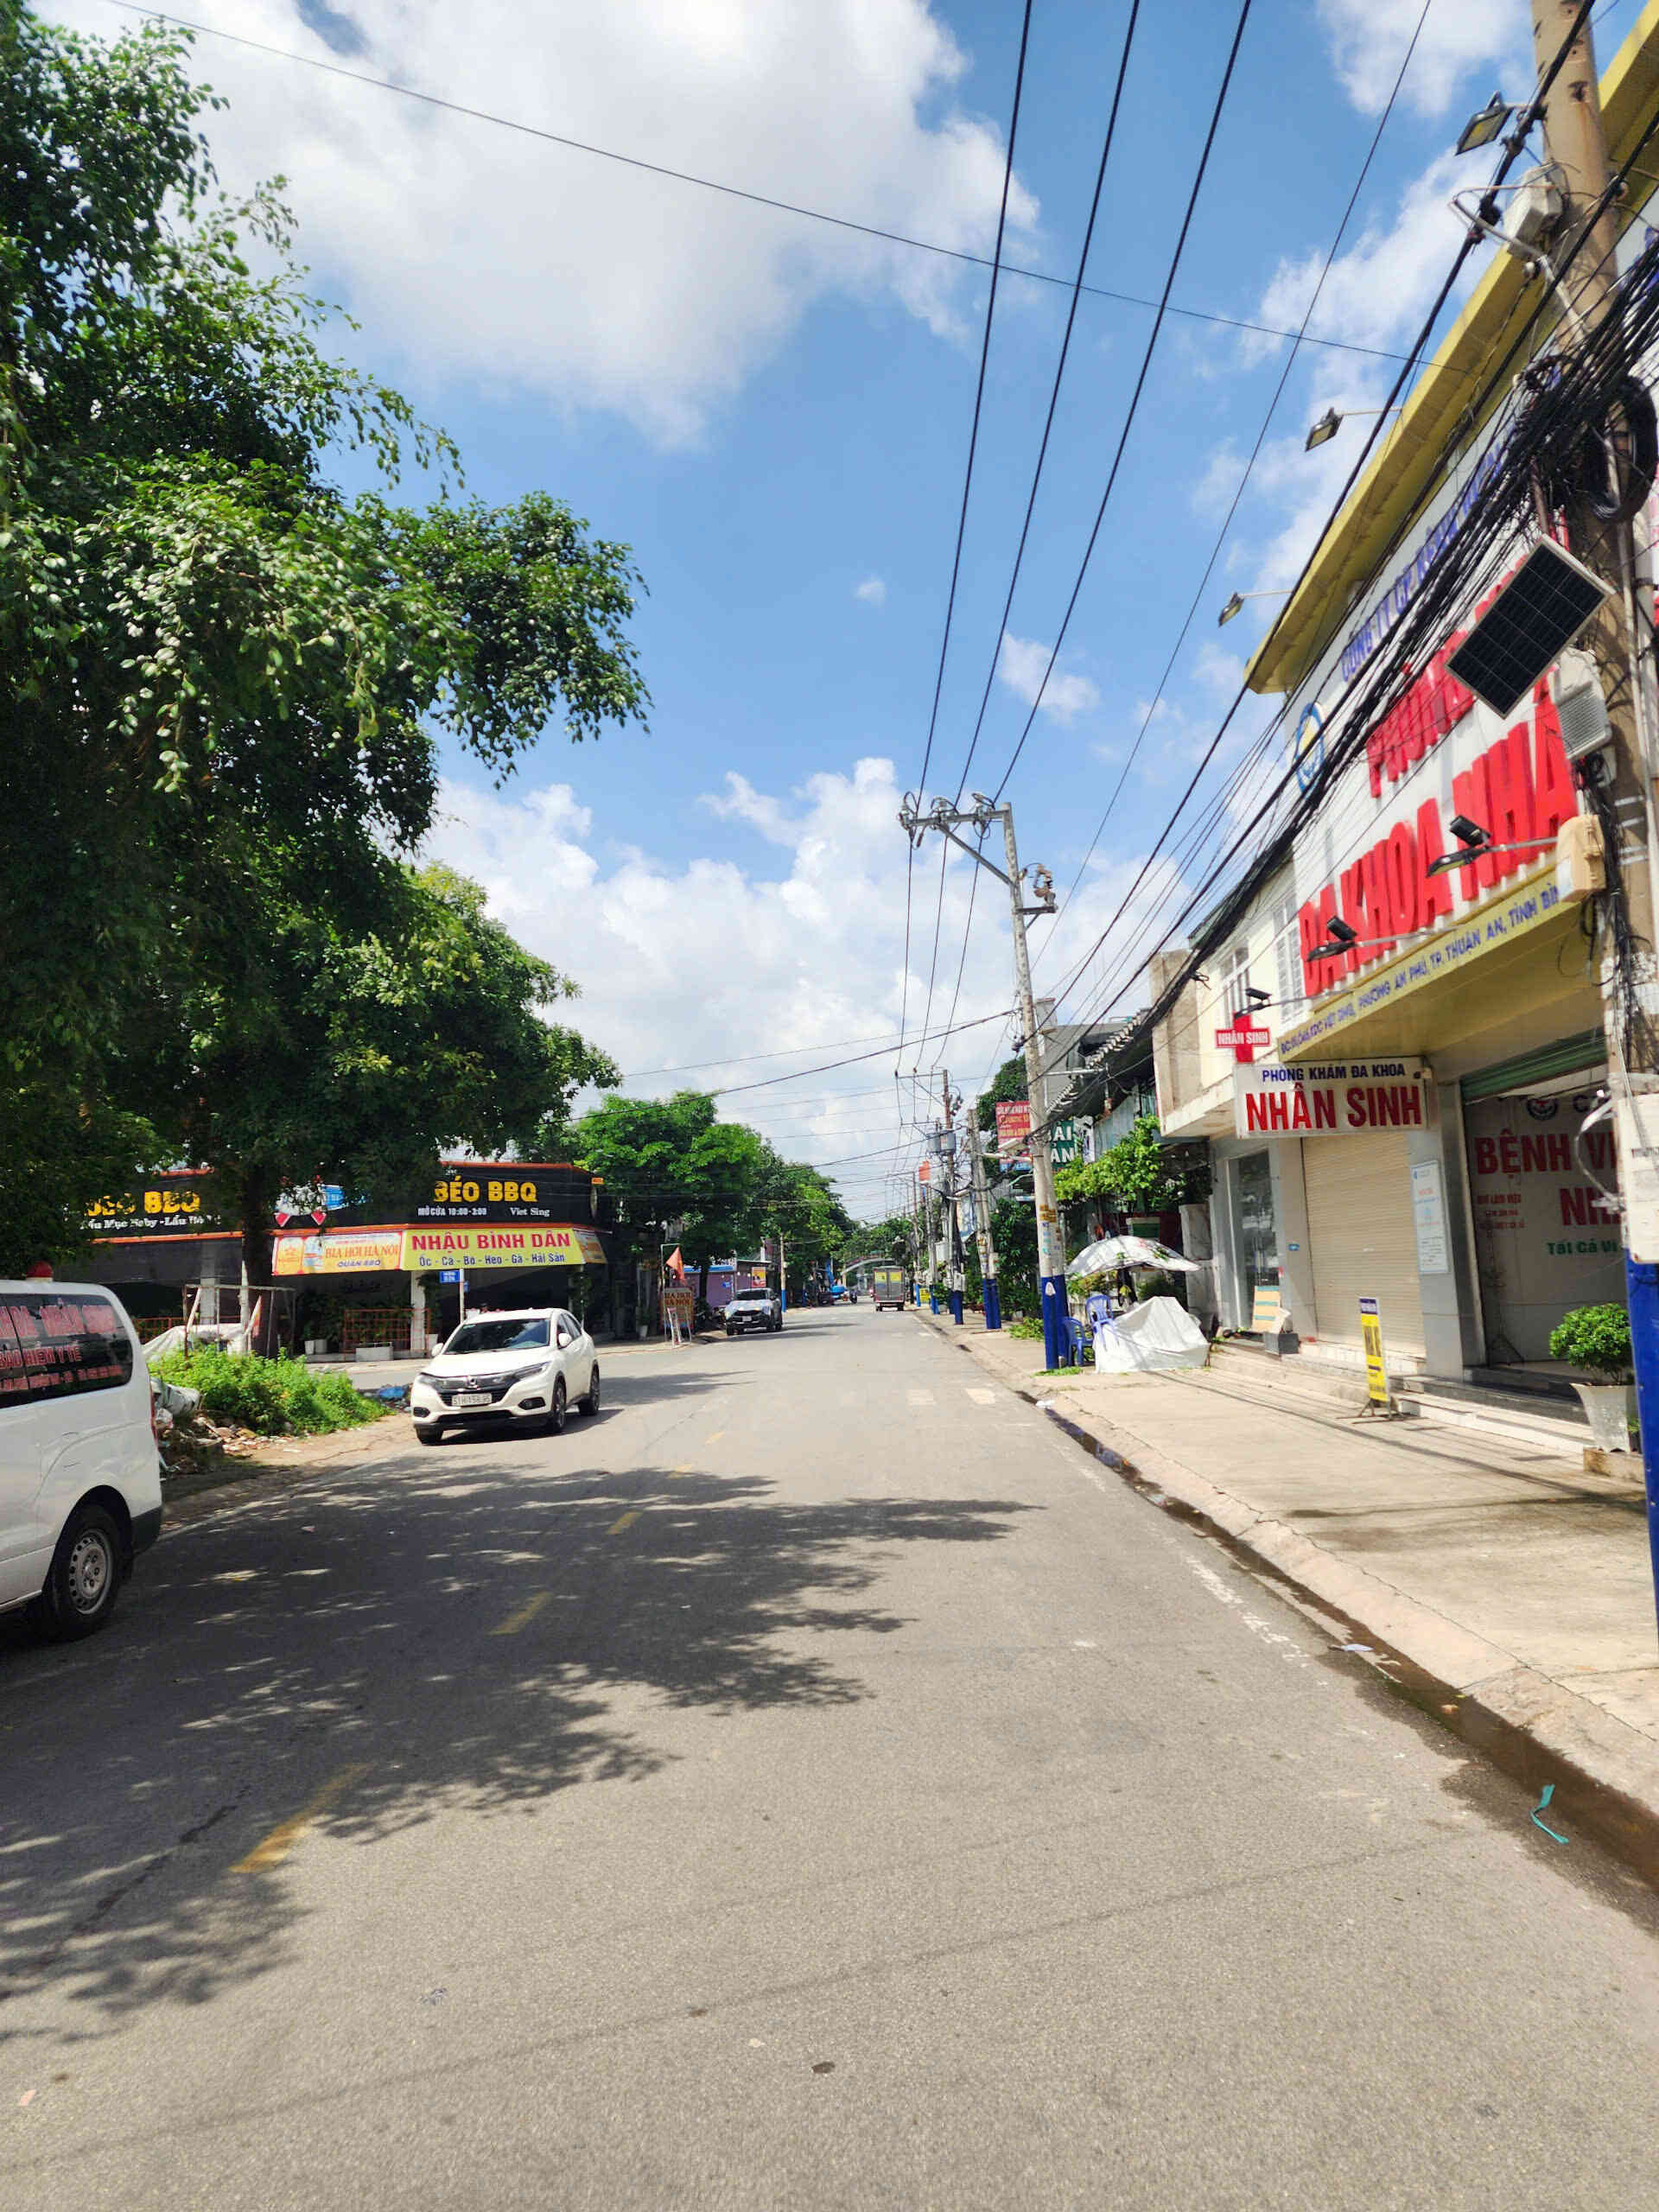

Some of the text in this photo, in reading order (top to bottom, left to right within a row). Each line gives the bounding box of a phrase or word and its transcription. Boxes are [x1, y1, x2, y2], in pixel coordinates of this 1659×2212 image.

[1338, 797, 1454, 975] KHOA
[1452, 667, 1580, 902] NHÂ
[1217, 1029, 1269, 1045] NHÂN SINH
[1262, 1063, 1406, 1083] PHÒNG KHÁM ĐA KHOA
[1245, 1083, 1422, 1131] NHÂN SINH
[1474, 1128, 1572, 1179] BỆNH
[433, 1175, 538, 1203] BÉO BBQ
[530, 1207, 550, 1217] Sing
[411, 1232, 470, 1254] NHẬU
[477, 1230, 525, 1249] BÌNH
[531, 1230, 571, 1248] DÂN
[485, 1253, 503, 1265] Heo
